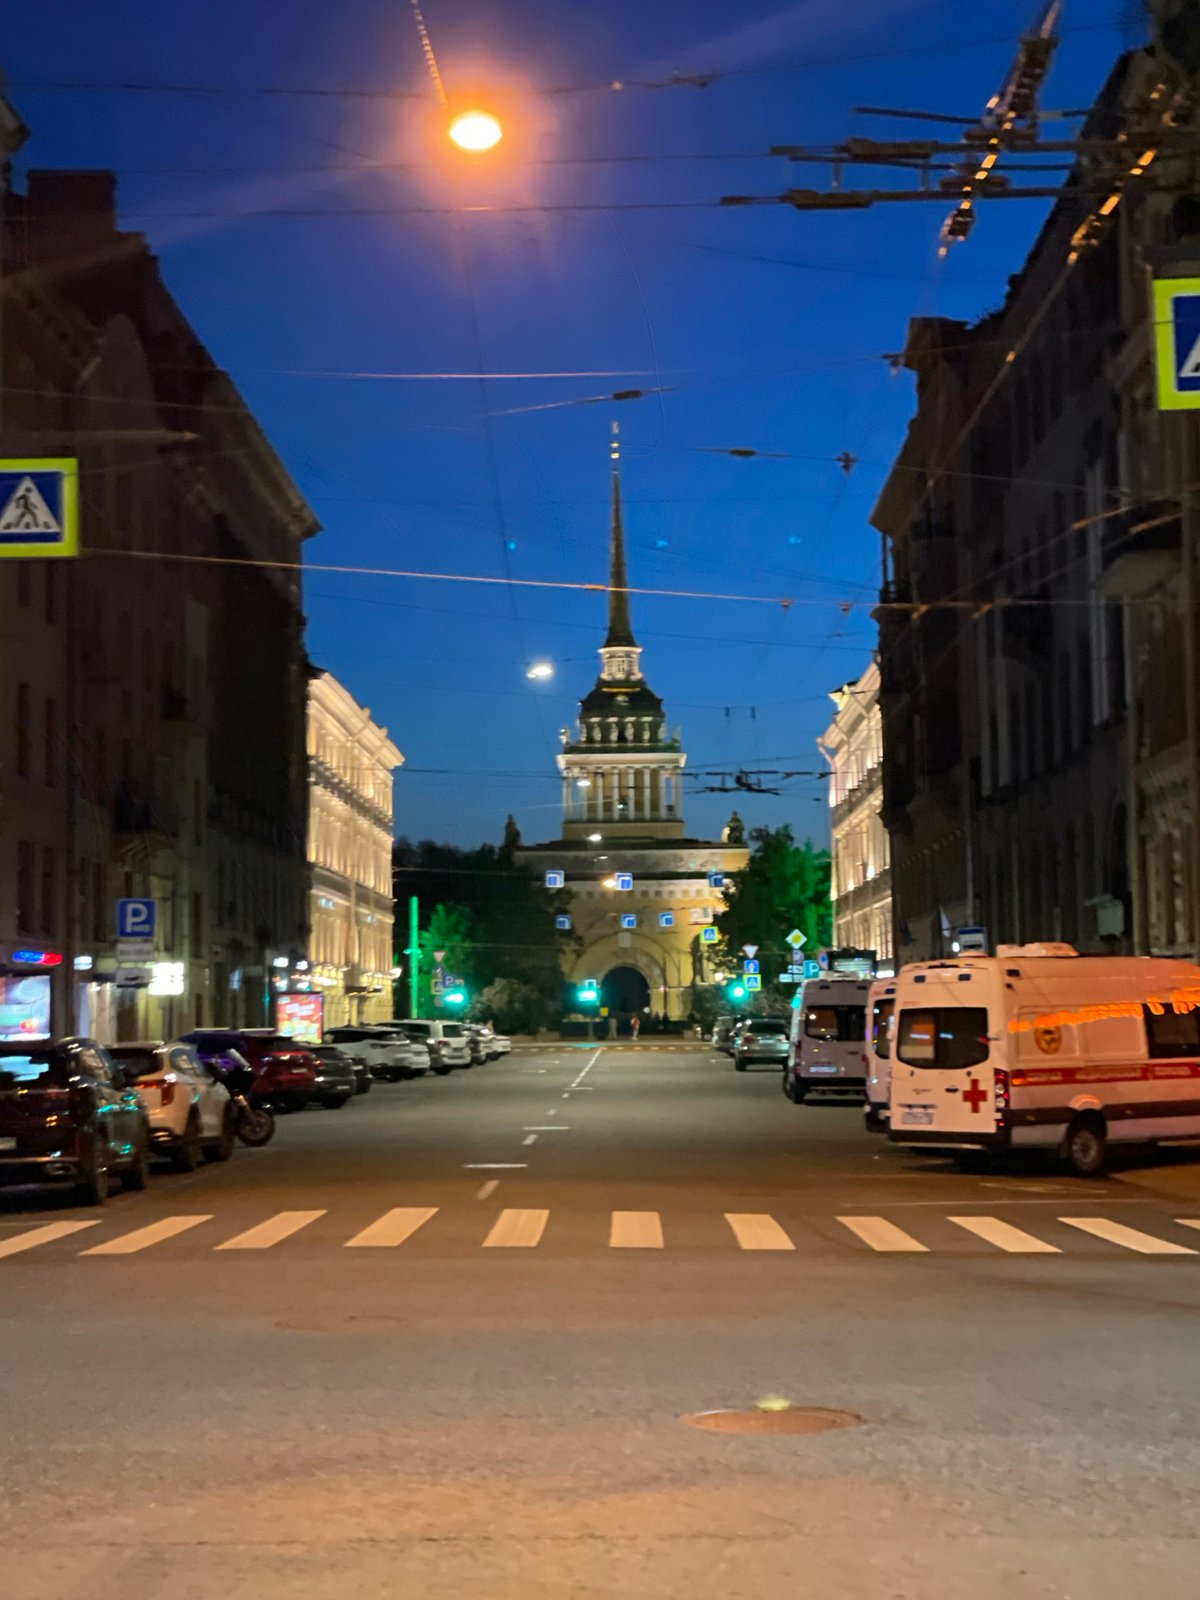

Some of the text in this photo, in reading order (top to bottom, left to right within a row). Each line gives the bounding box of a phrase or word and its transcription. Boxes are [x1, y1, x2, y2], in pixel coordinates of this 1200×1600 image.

[125, 902, 148, 933] P
[810, 963, 820, 976] P
[445, 975, 454, 986] P
